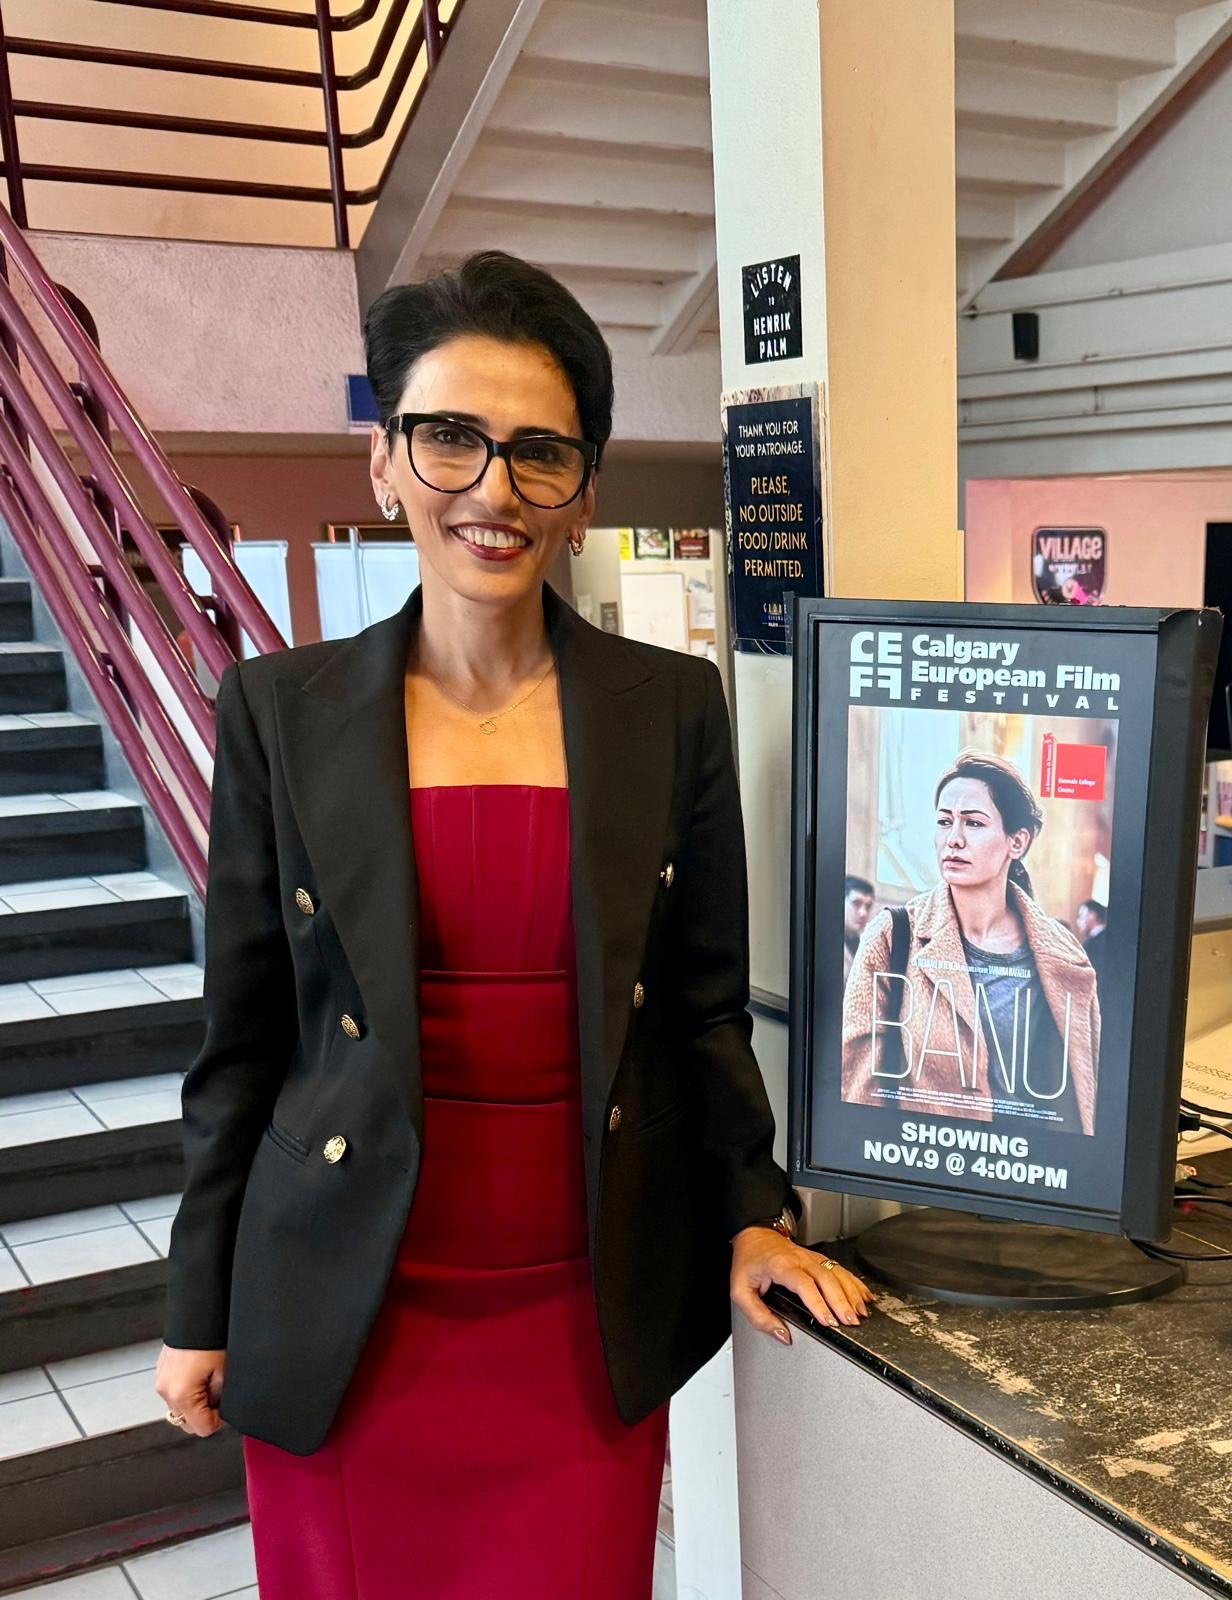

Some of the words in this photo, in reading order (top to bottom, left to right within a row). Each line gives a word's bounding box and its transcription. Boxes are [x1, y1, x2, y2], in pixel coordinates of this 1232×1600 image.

[750, 263, 792, 298] LISTEN
[753, 312, 791, 336] HENRIK
[759, 337, 787, 359] PALM
[738, 424, 764, 438] THANK
[765, 422, 781, 436] YOU
[782, 420, 799, 434] FOR
[735, 444, 756, 458] YOUR
[757, 441, 806, 456] PATRONAGE.
[751, 476, 791, 496] PLEASE,
[740, 505, 756, 522] NO
[758, 504, 804, 522] OUTSIDE
[738, 532, 808, 551] FOOD/DRINK
[744, 559, 804, 578] PERMITTED.
[912, 634, 1020, 666] Calgary
[911, 661, 1046, 690] European
[1056, 665, 1120, 691] Film
[911, 688, 1119, 710] FESTIVAL
[870, 971, 1072, 1100] BANU
[901, 1121, 1029, 1158] SHOWING
[864, 1140, 939, 1170] NOV.9
[946, 1153, 965, 1176] @
[971, 1156, 1068, 1190] 4:00PM
